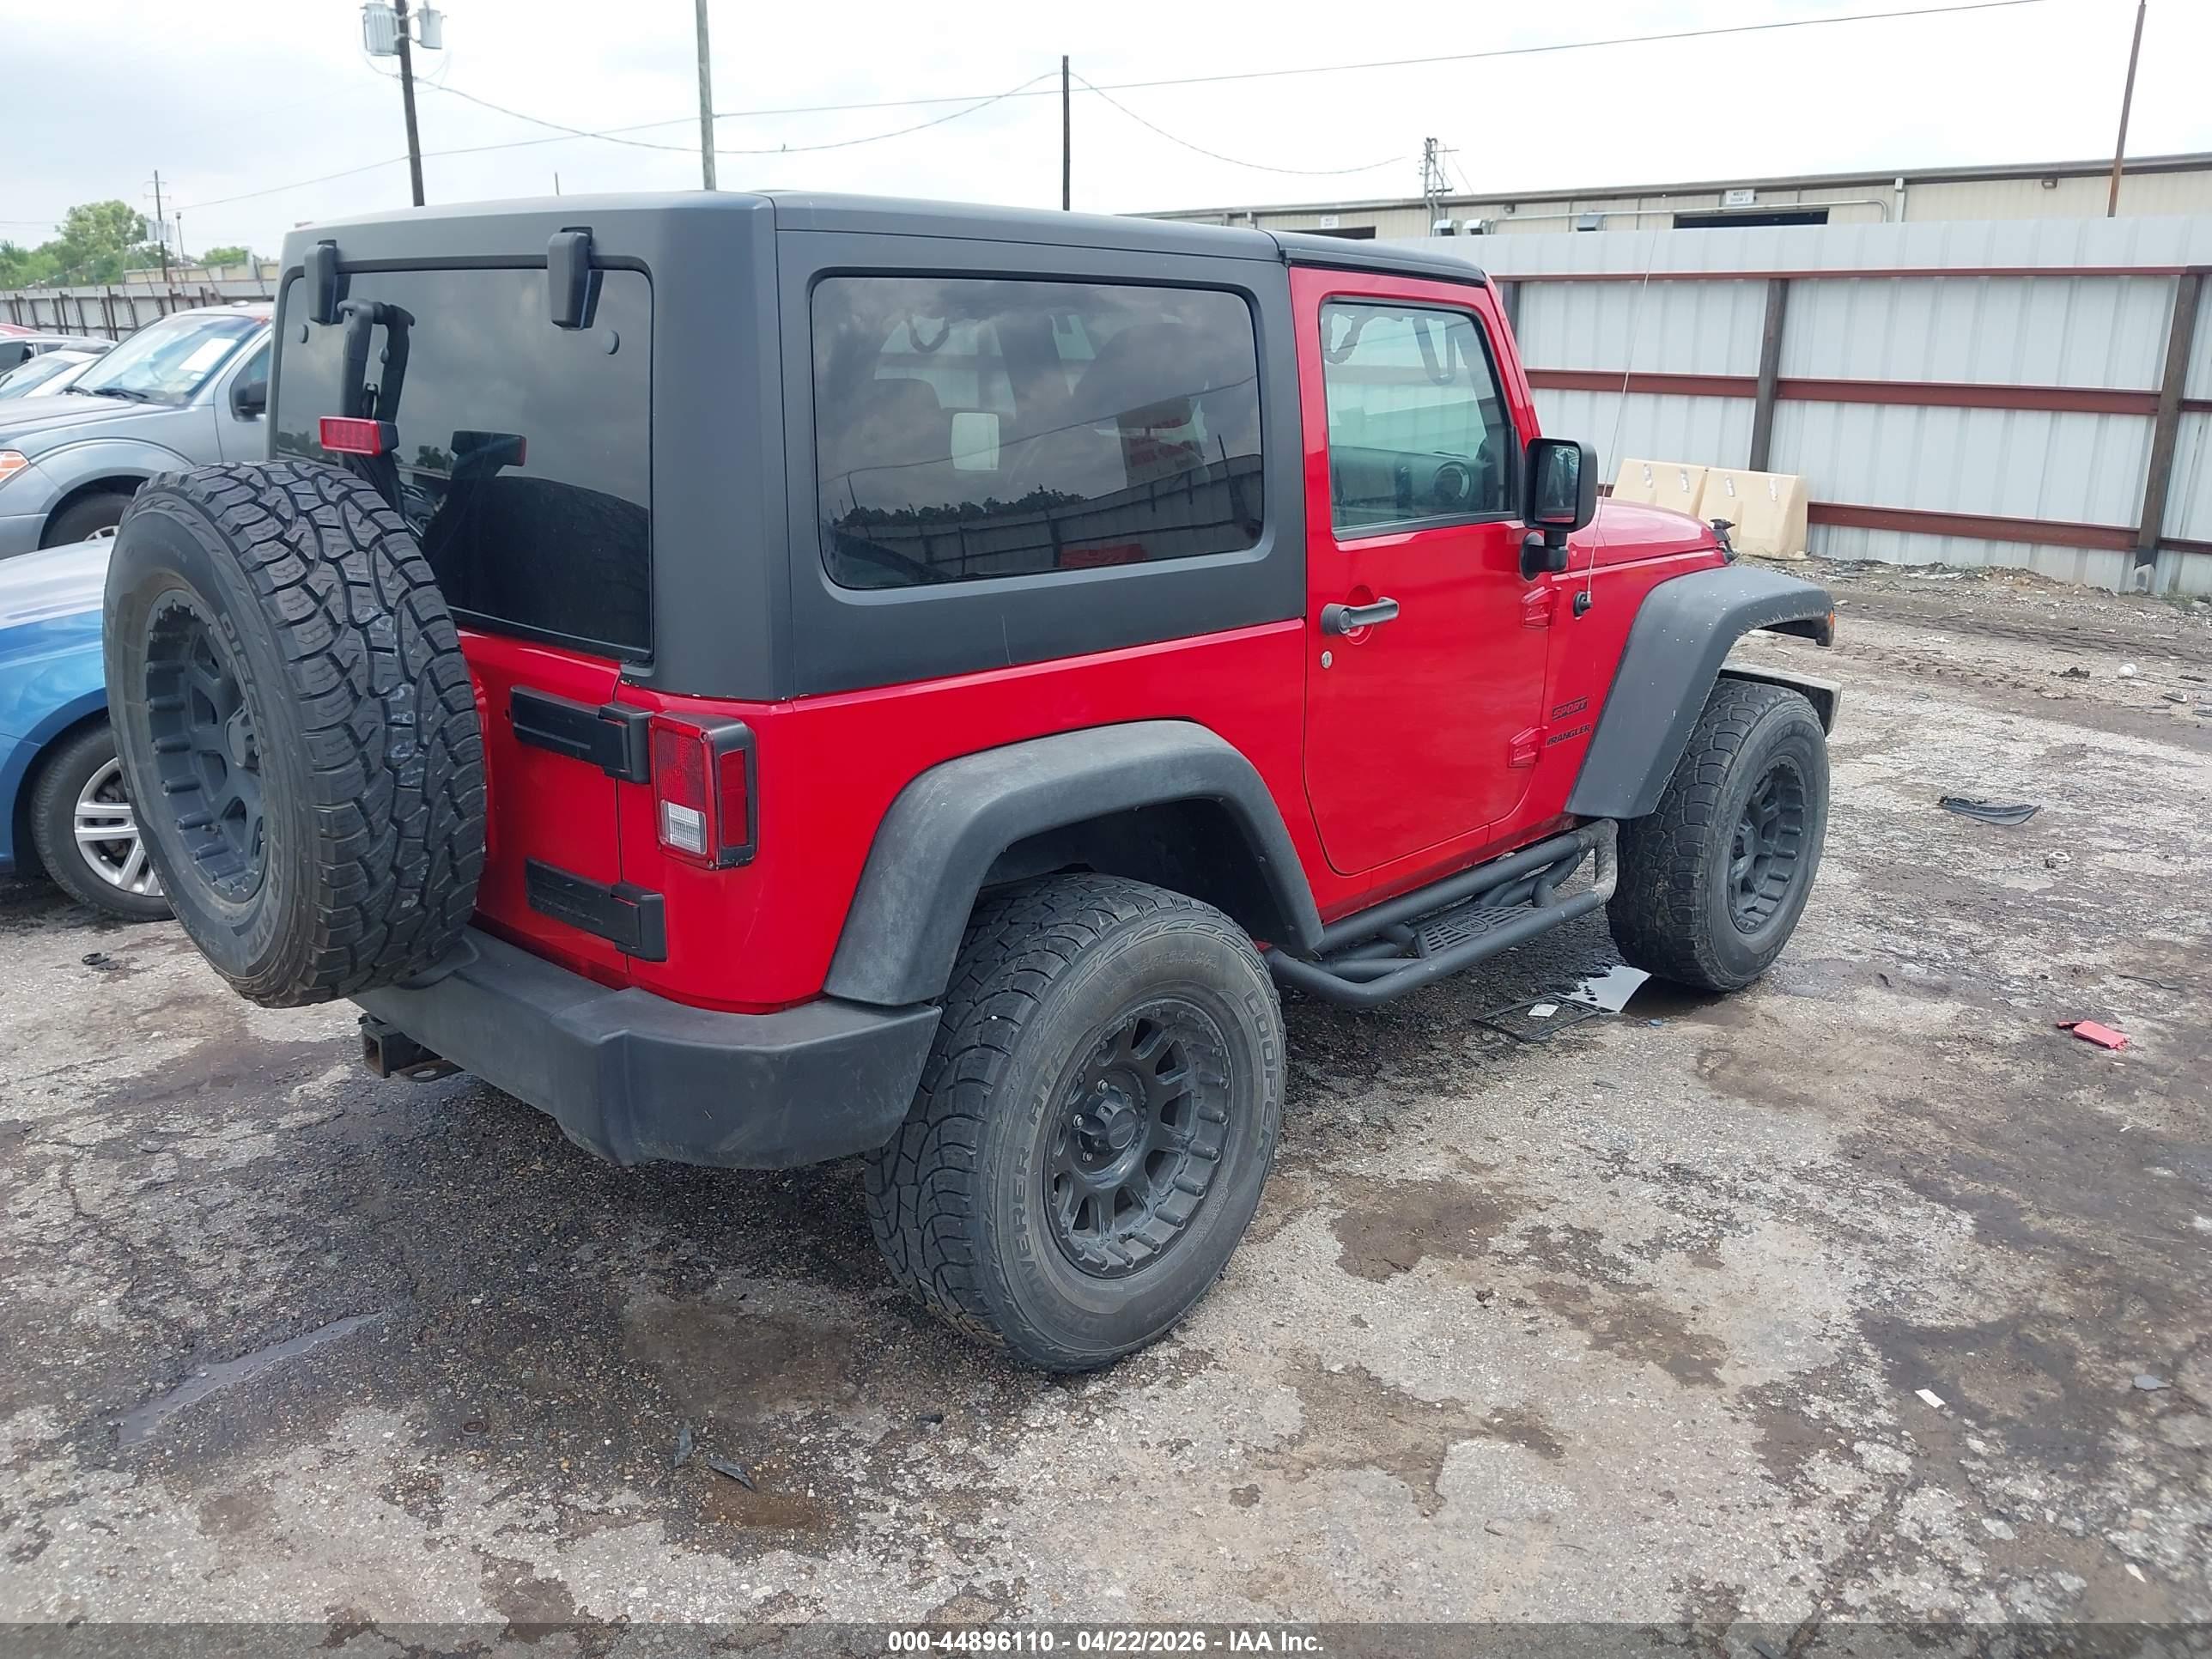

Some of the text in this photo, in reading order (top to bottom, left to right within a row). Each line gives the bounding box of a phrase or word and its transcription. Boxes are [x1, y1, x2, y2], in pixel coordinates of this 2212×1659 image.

[1553, 698, 1588, 718] SPORT
[1546, 724, 1591, 746] WRANGLER
[1243, 989, 1278, 1163] COOPER
